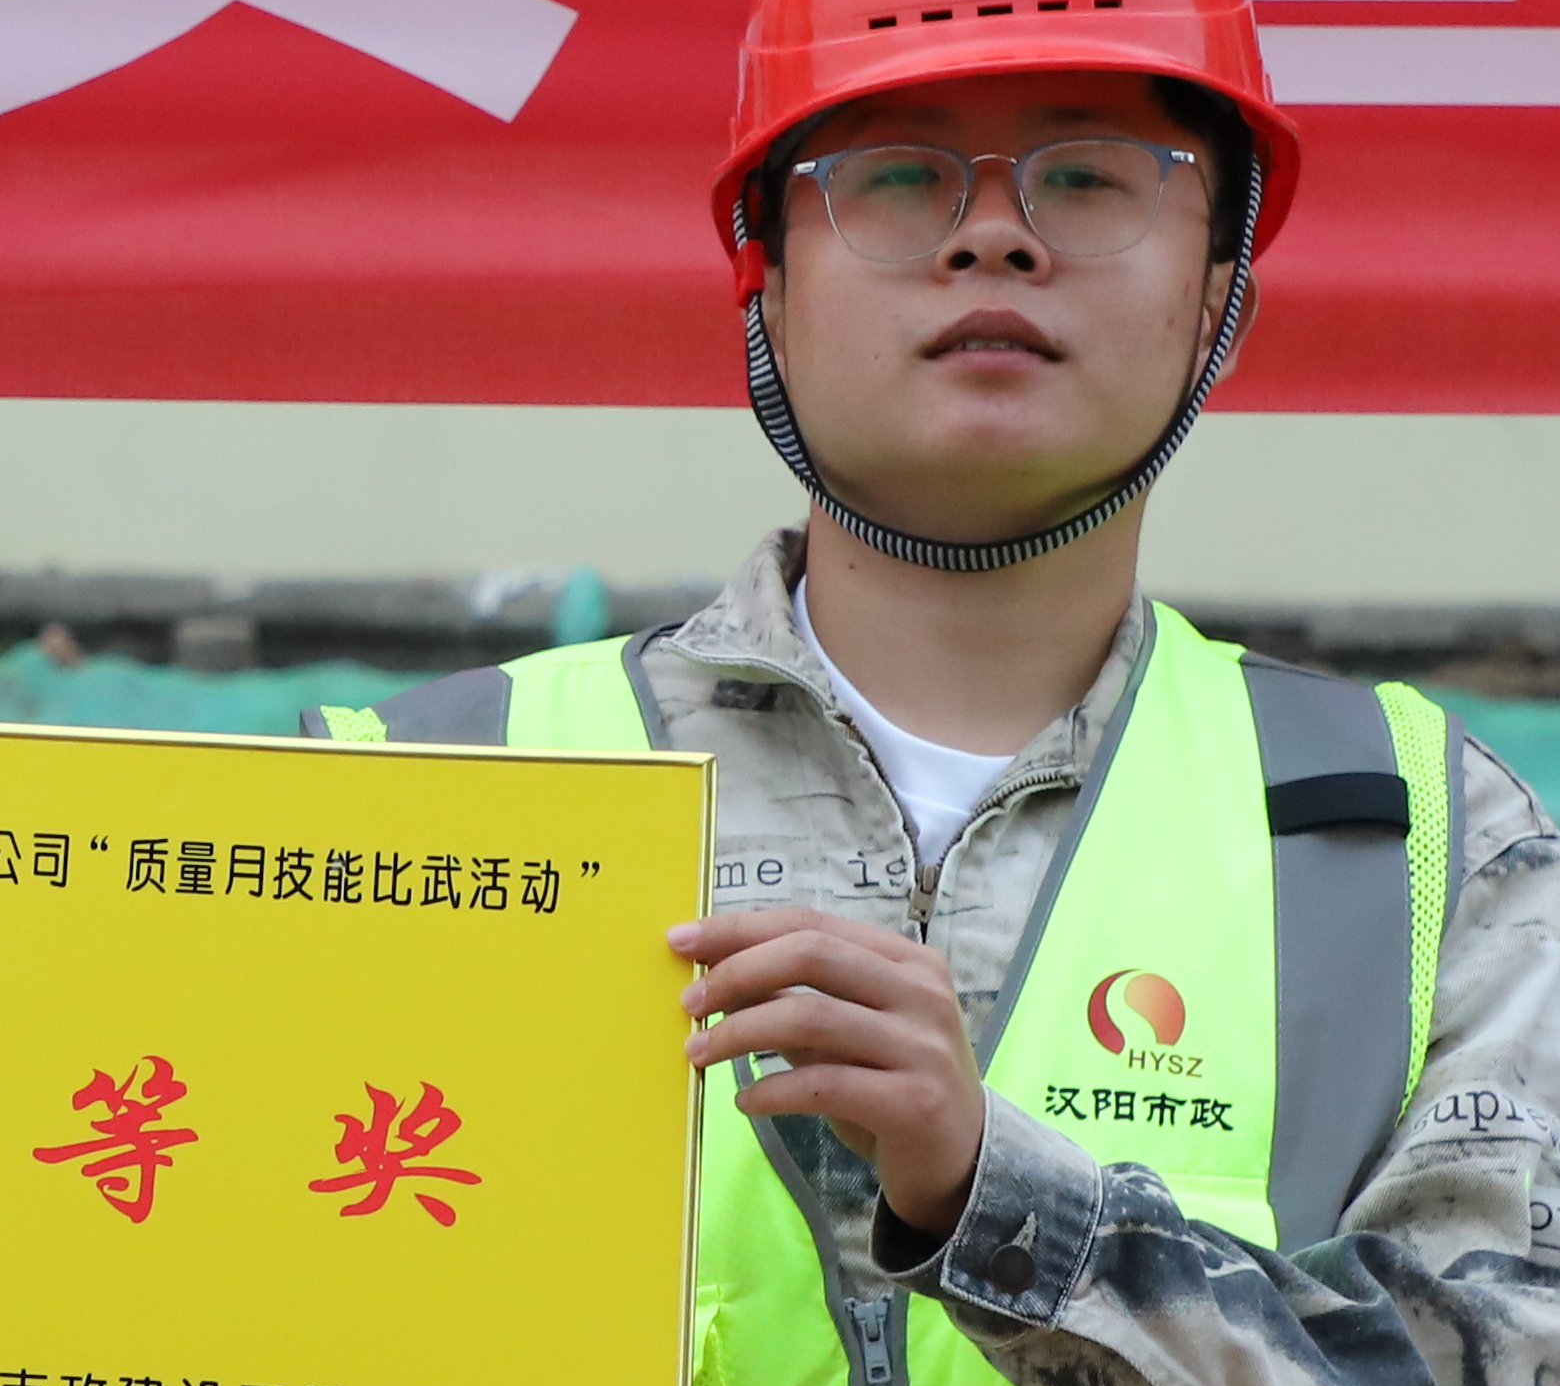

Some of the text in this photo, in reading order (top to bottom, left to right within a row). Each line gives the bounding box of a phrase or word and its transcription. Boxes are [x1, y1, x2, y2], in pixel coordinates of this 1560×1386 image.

[1128, 1049, 1204, 1078] HYSZ
[1044, 1084, 1235, 1132] 汉阳市政
